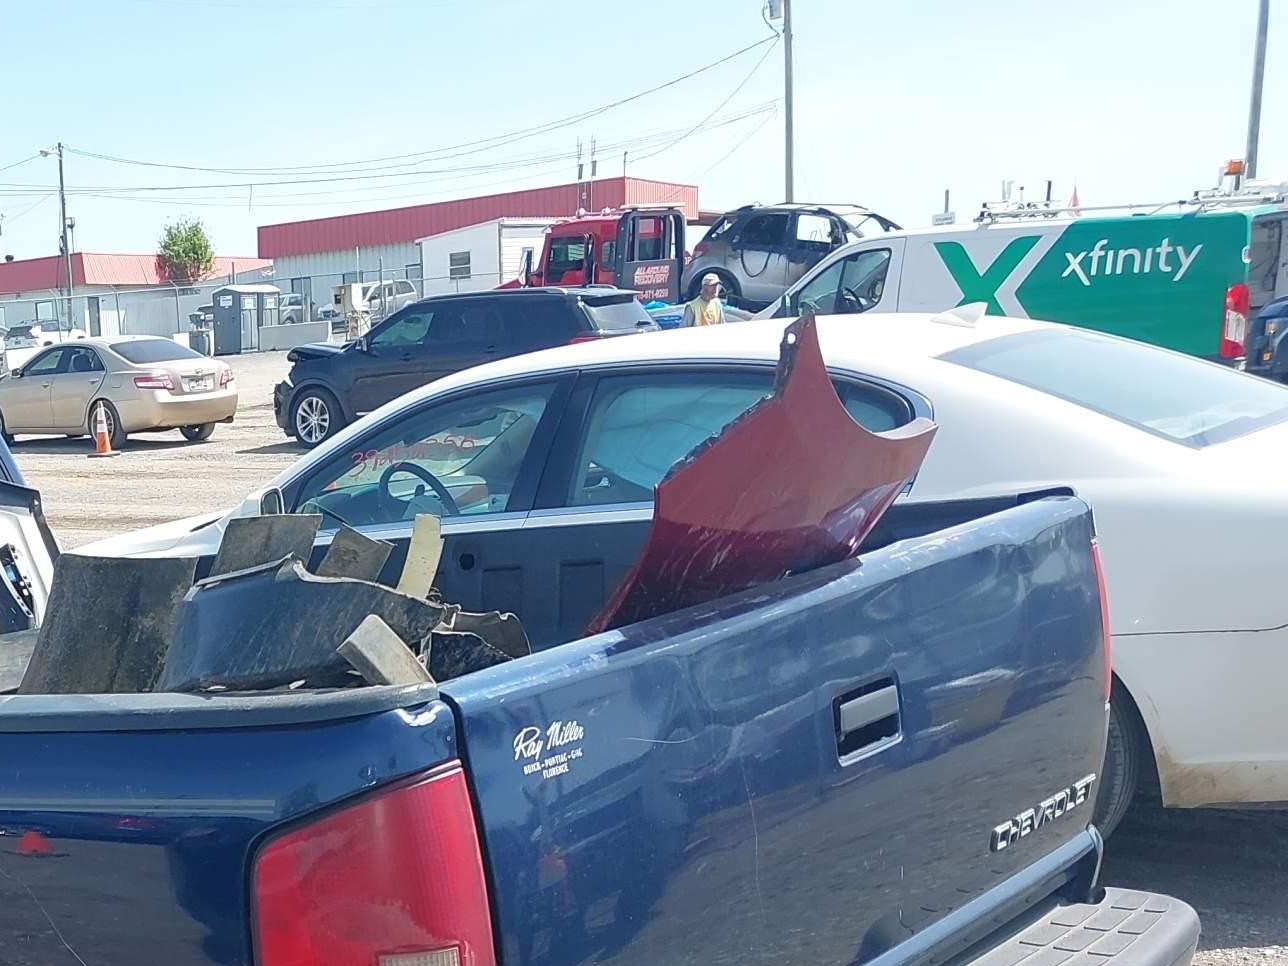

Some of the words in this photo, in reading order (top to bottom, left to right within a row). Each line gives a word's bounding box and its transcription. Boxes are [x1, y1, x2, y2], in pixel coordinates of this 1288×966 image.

[633, 272, 669, 286] RECOVERY
[1061, 237, 1204, 286] xfinity
[514, 726, 543, 761] Ray
[546, 720, 584, 750] Miller
[542, 763, 569, 779] FLORENCE
[990, 773, 1097, 852] CHEVROLET
